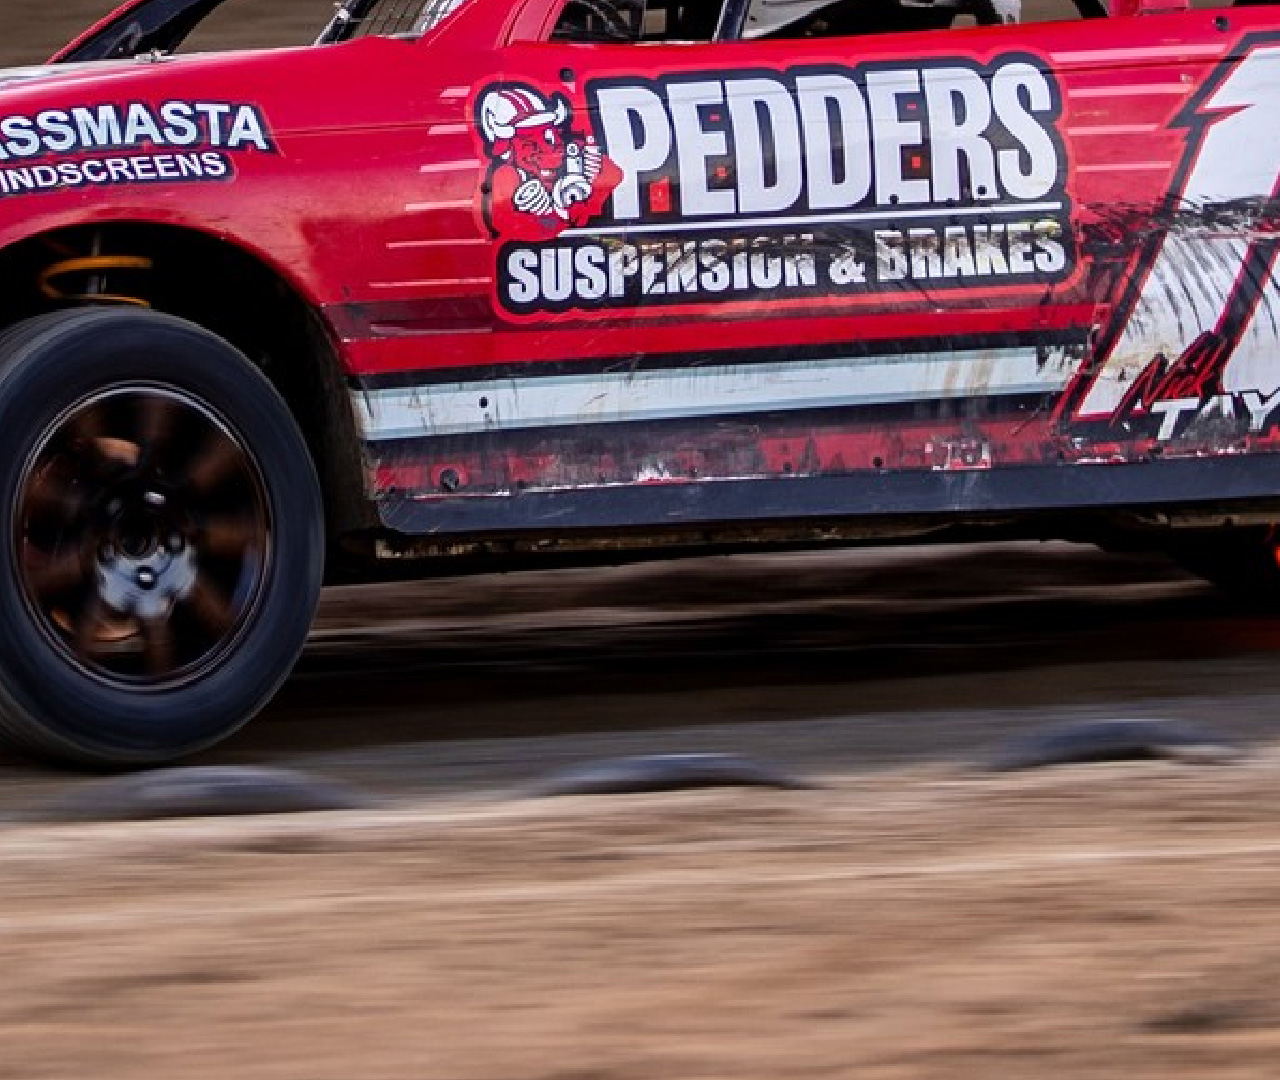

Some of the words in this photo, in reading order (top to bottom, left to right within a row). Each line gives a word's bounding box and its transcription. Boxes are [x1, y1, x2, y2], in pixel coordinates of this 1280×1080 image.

[596, 62, 1064, 220] PEDDERS
[507, 234, 818, 304] SUSPENSION
[829, 245, 867, 286] &
[875, 219, 1068, 284] BRAKES
